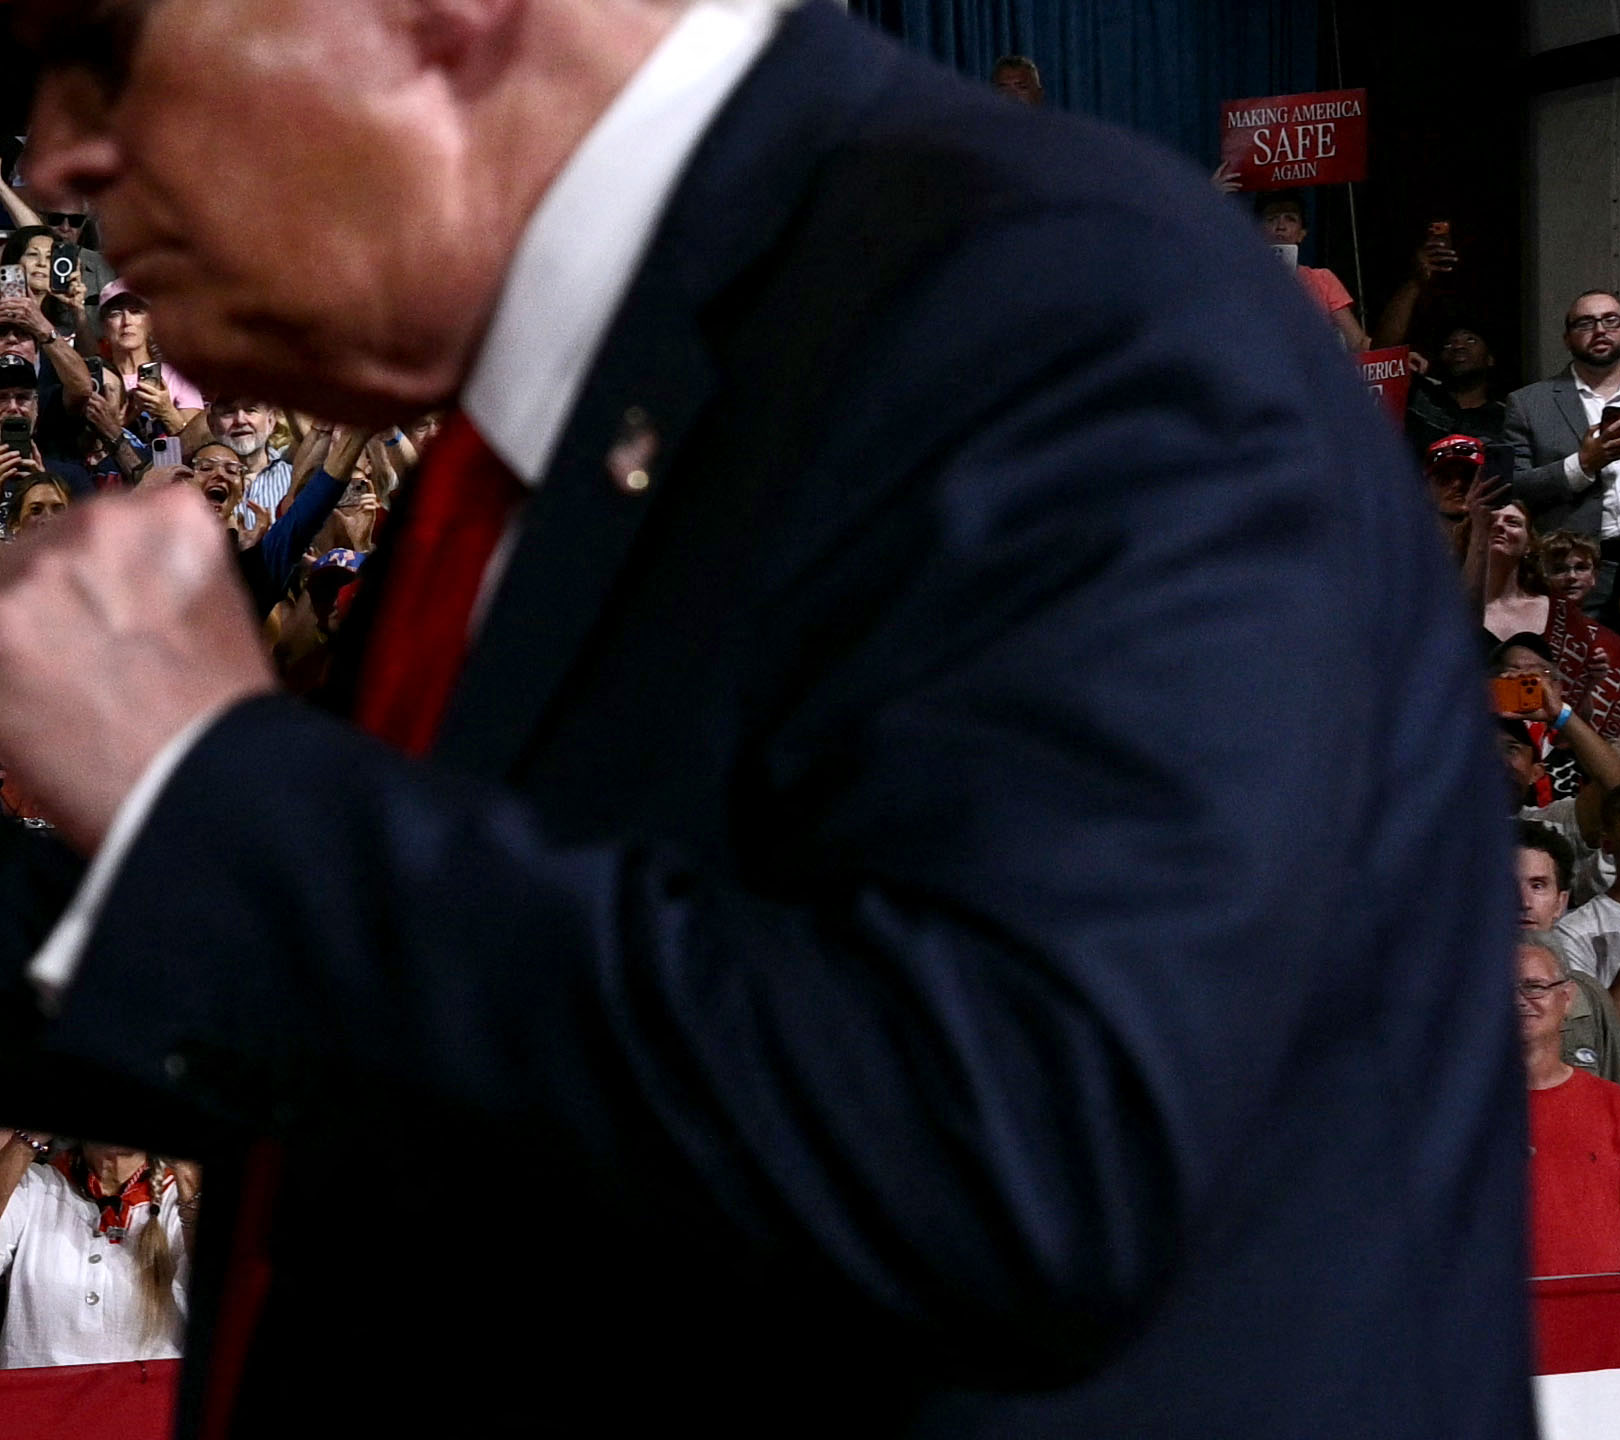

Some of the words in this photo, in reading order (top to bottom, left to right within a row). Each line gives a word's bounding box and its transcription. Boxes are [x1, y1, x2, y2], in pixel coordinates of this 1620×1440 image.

[1227, 108, 1289, 133] MAKING
[1291, 101, 1362, 123] AMERICA
[1253, 122, 1337, 166] SAFE
[1271, 161, 1318, 182] AGAIN
[1363, 360, 1405, 381] ERICA
